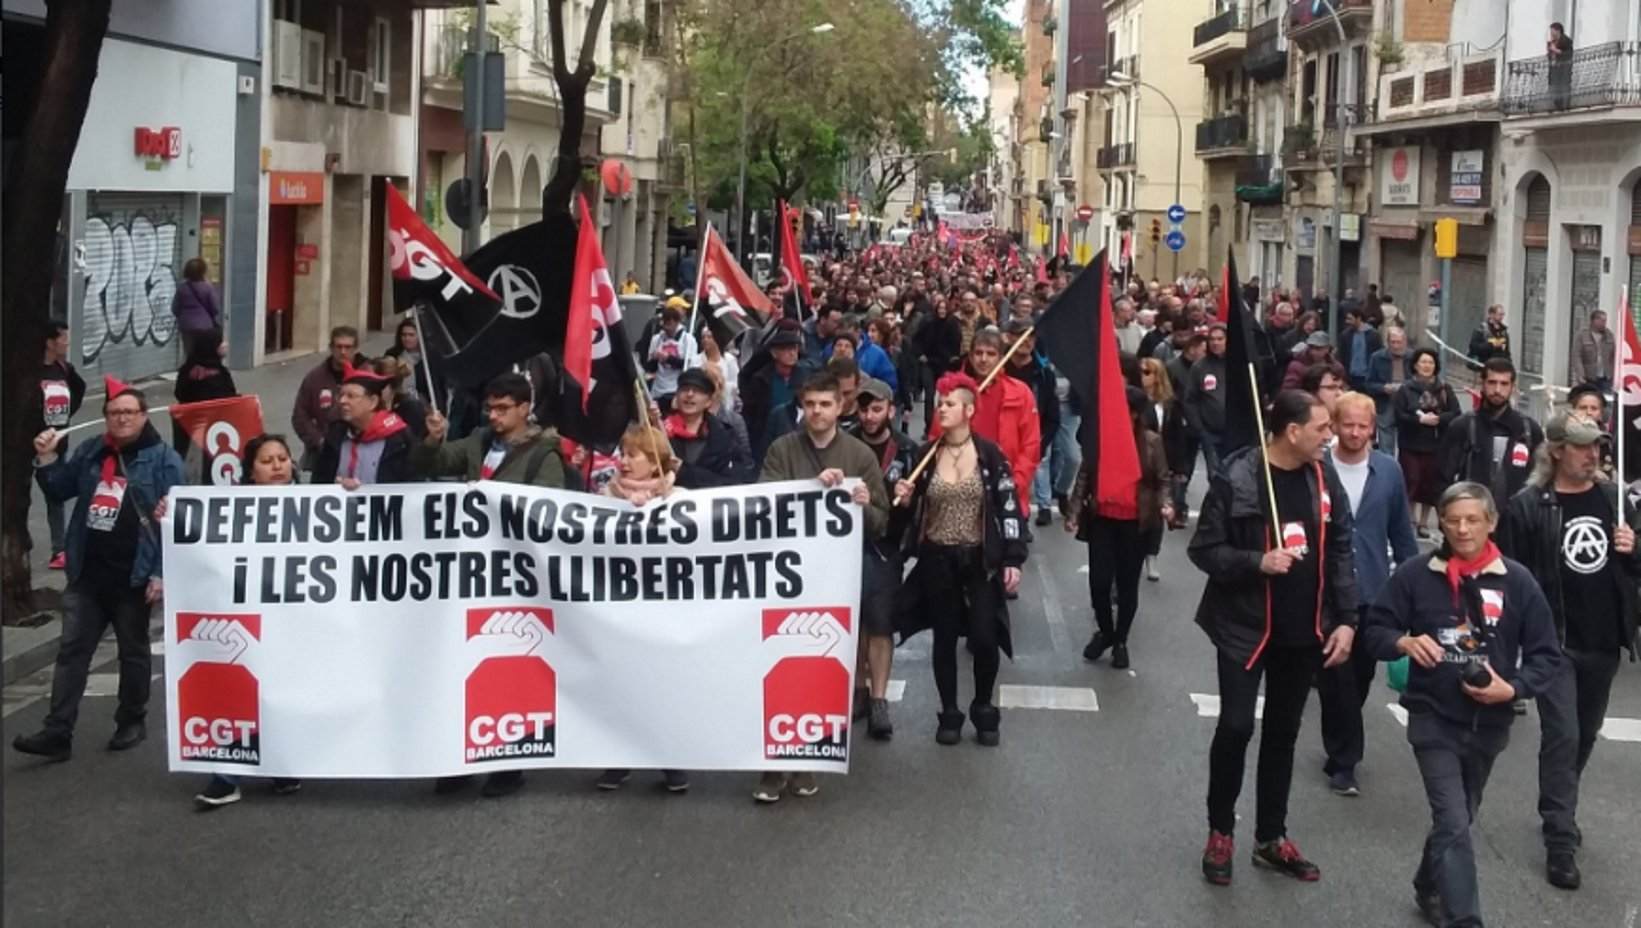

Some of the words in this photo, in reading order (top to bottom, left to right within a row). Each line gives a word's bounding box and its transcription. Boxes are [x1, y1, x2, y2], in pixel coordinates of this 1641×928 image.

[174, 495, 404, 544] DEFENSEM
[424, 490, 490, 539] ELS
[500, 493, 698, 545] NOSTRES
[711, 489, 854, 543] DRETS
[233, 557, 247, 604] i
[261, 556, 337, 604] LES
[351, 550, 539, 603] NOSTRES
[548, 550, 803, 602] LLIBERTATS
[184, 716, 256, 747] CGT
[469, 712, 553, 745] CGT
[768, 713, 847, 744] CGT
[183, 746, 258, 761] BARCELONA
[466, 742, 553, 760] BARCELONA
[767, 743, 847, 758] BARCELONA
